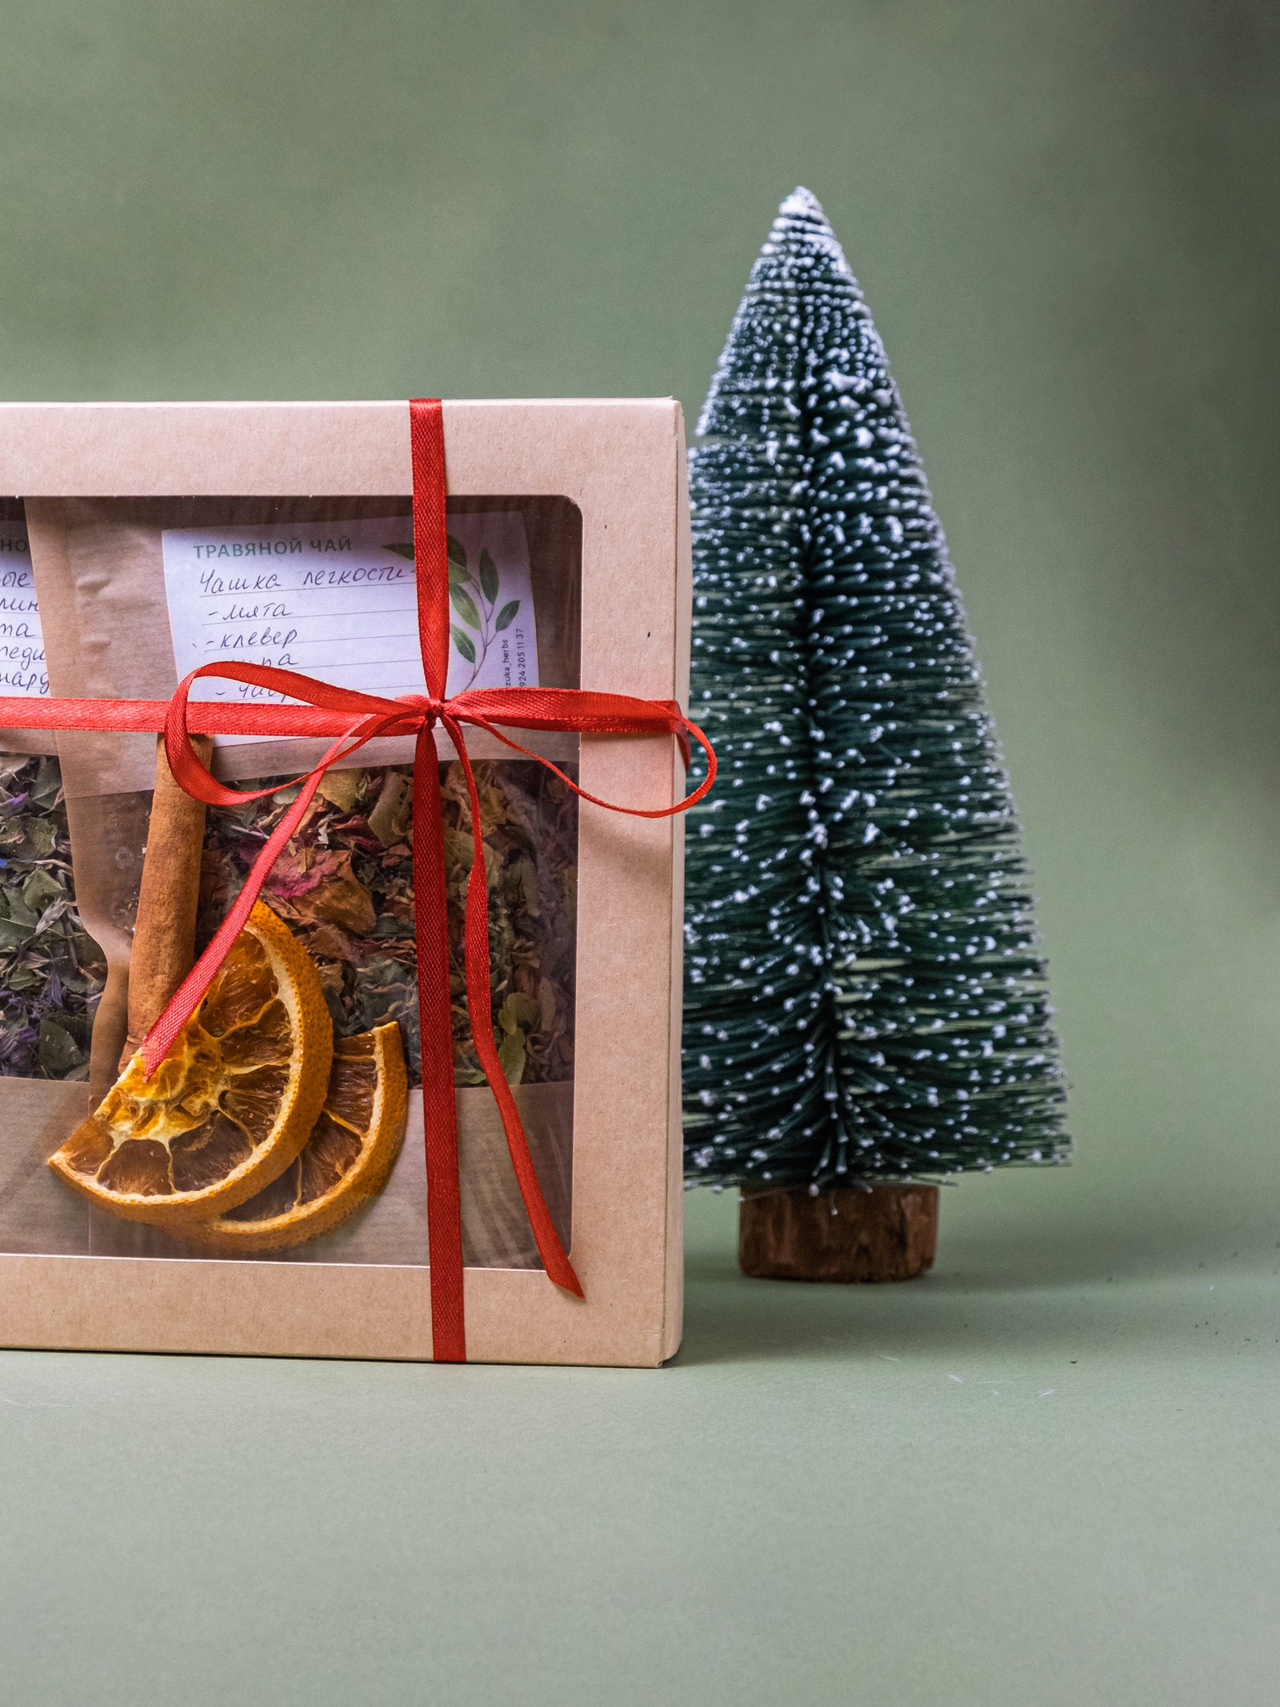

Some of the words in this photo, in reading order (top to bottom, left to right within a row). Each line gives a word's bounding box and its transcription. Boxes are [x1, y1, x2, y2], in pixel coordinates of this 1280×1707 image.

[193, 537, 303, 559] ТРАВЯНОЙ
[310, 535, 352, 553] ЧАЙ
[199, 569, 282, 594] Чашка
[516, 628, 524, 639] 37
[517, 641, 525, 649] 11
[517, 652, 526, 668] 205
[519, 670, 527, 687] 924
